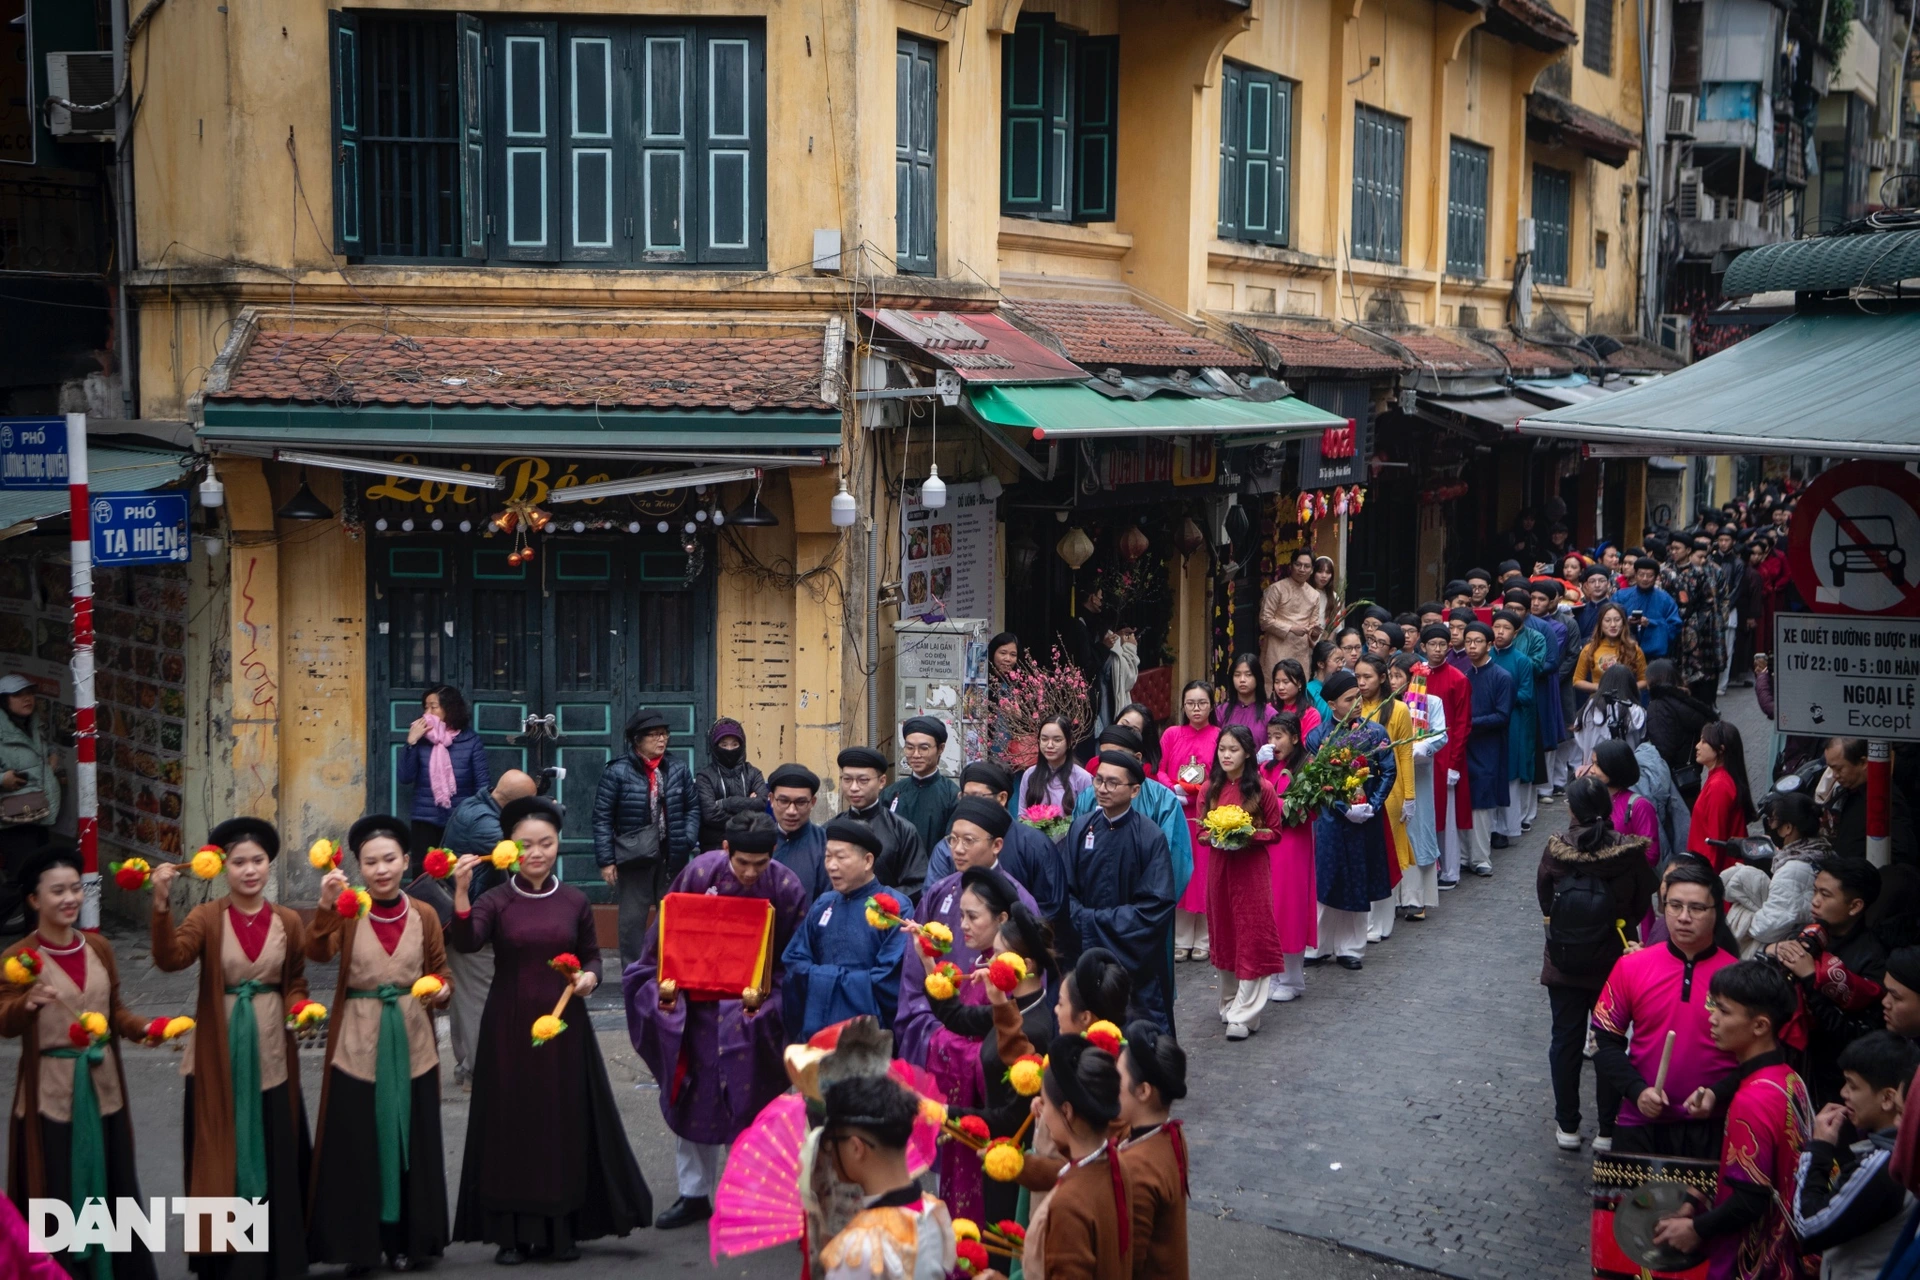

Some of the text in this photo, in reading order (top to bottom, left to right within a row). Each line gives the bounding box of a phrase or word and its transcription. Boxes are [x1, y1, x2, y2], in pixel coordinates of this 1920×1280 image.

[21, 426, 46, 444] PHỐ
[3, 446, 68, 482] LƯƠNG NGỌC QUYẾN
[365, 453, 610, 514] Lợi Béo
[124, 500, 157, 520] PHỐ
[638, 499, 651, 508] Tạ
[103, 522, 178, 557] TẠ HIỆN
[929, 643, 939, 652] LẠI
[1783, 628, 1797, 643] XE
[1801, 626, 1829, 645] QUÉT
[1832, 627, 1871, 647] ĐƯỜNG
[1874, 631, 1906, 651] ĐƯỢC
[1843, 683, 1915, 709] NGOẠI LỆ
[1848, 709, 1912, 733] Except
